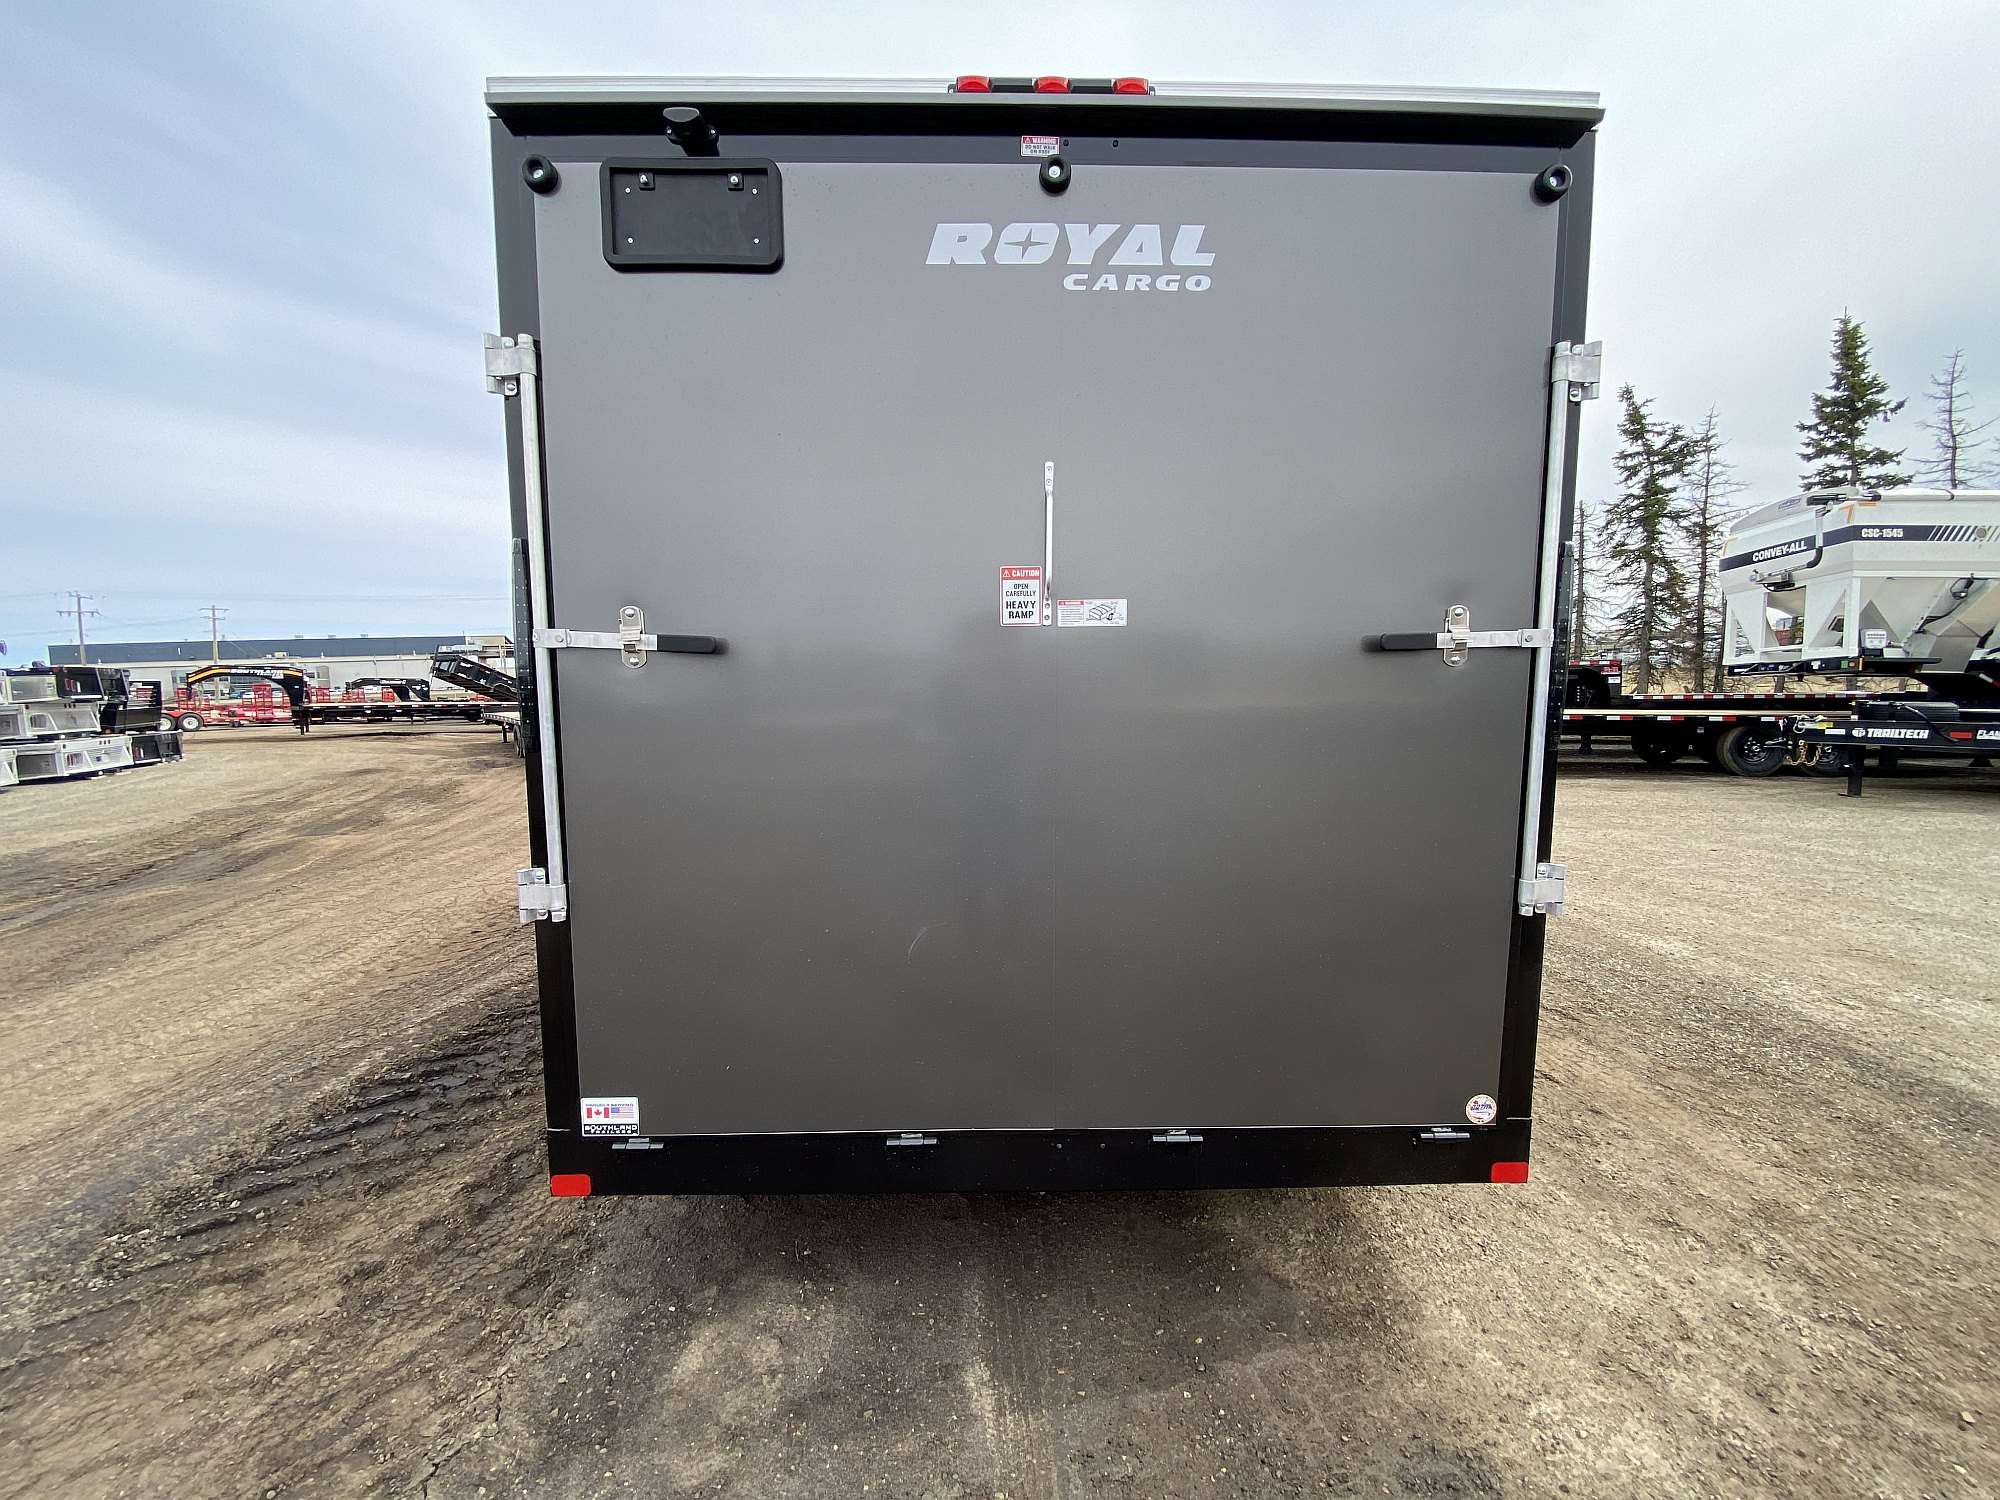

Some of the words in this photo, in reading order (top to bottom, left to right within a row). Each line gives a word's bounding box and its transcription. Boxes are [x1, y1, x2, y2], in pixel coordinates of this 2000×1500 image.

[925, 222, 1216, 266] ROYAL
[1063, 273, 1212, 292] CARGO
[1861, 528, 1904, 538] CSC-1545
[1752, 541, 1807, 562] CONVEY-ALL
[1011, 569, 1040, 577] CAUTION
[1006, 601, 1036, 609] HEAVY
[1008, 611, 1034, 619] RAMP
[1867, 728, 1929, 739] TRAILTECH
